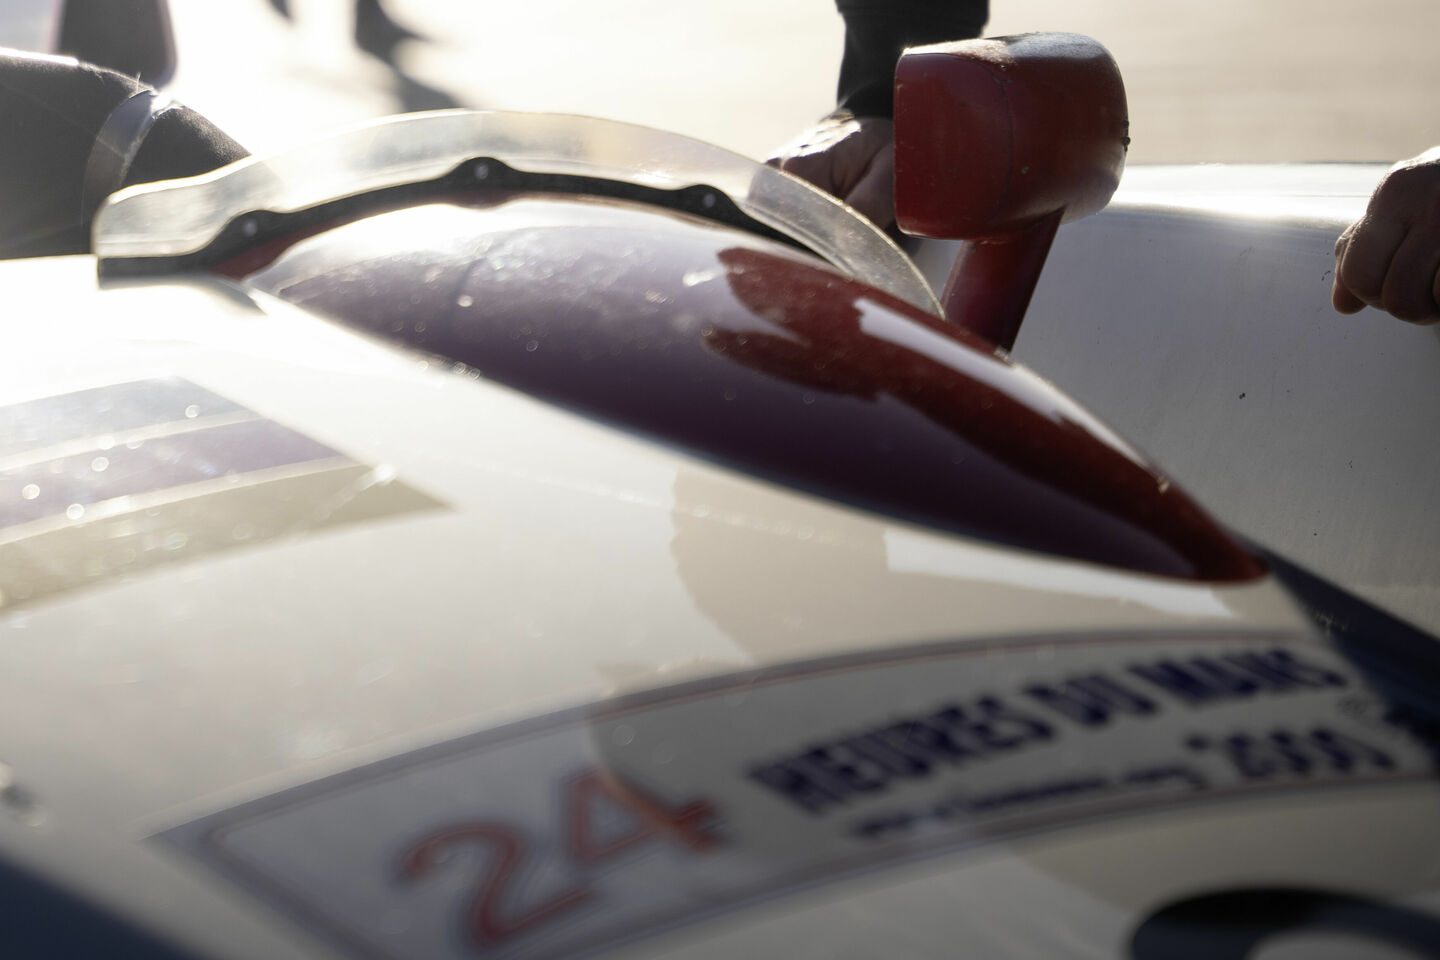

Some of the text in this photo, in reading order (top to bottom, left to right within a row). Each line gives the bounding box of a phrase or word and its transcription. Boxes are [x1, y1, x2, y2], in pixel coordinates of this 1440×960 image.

[395, 764, 722, 948] 24
[746, 693, 1056, 816] HEURES
[1022, 672, 1160, 730] DU
[1123, 645, 1350, 708] MANS
